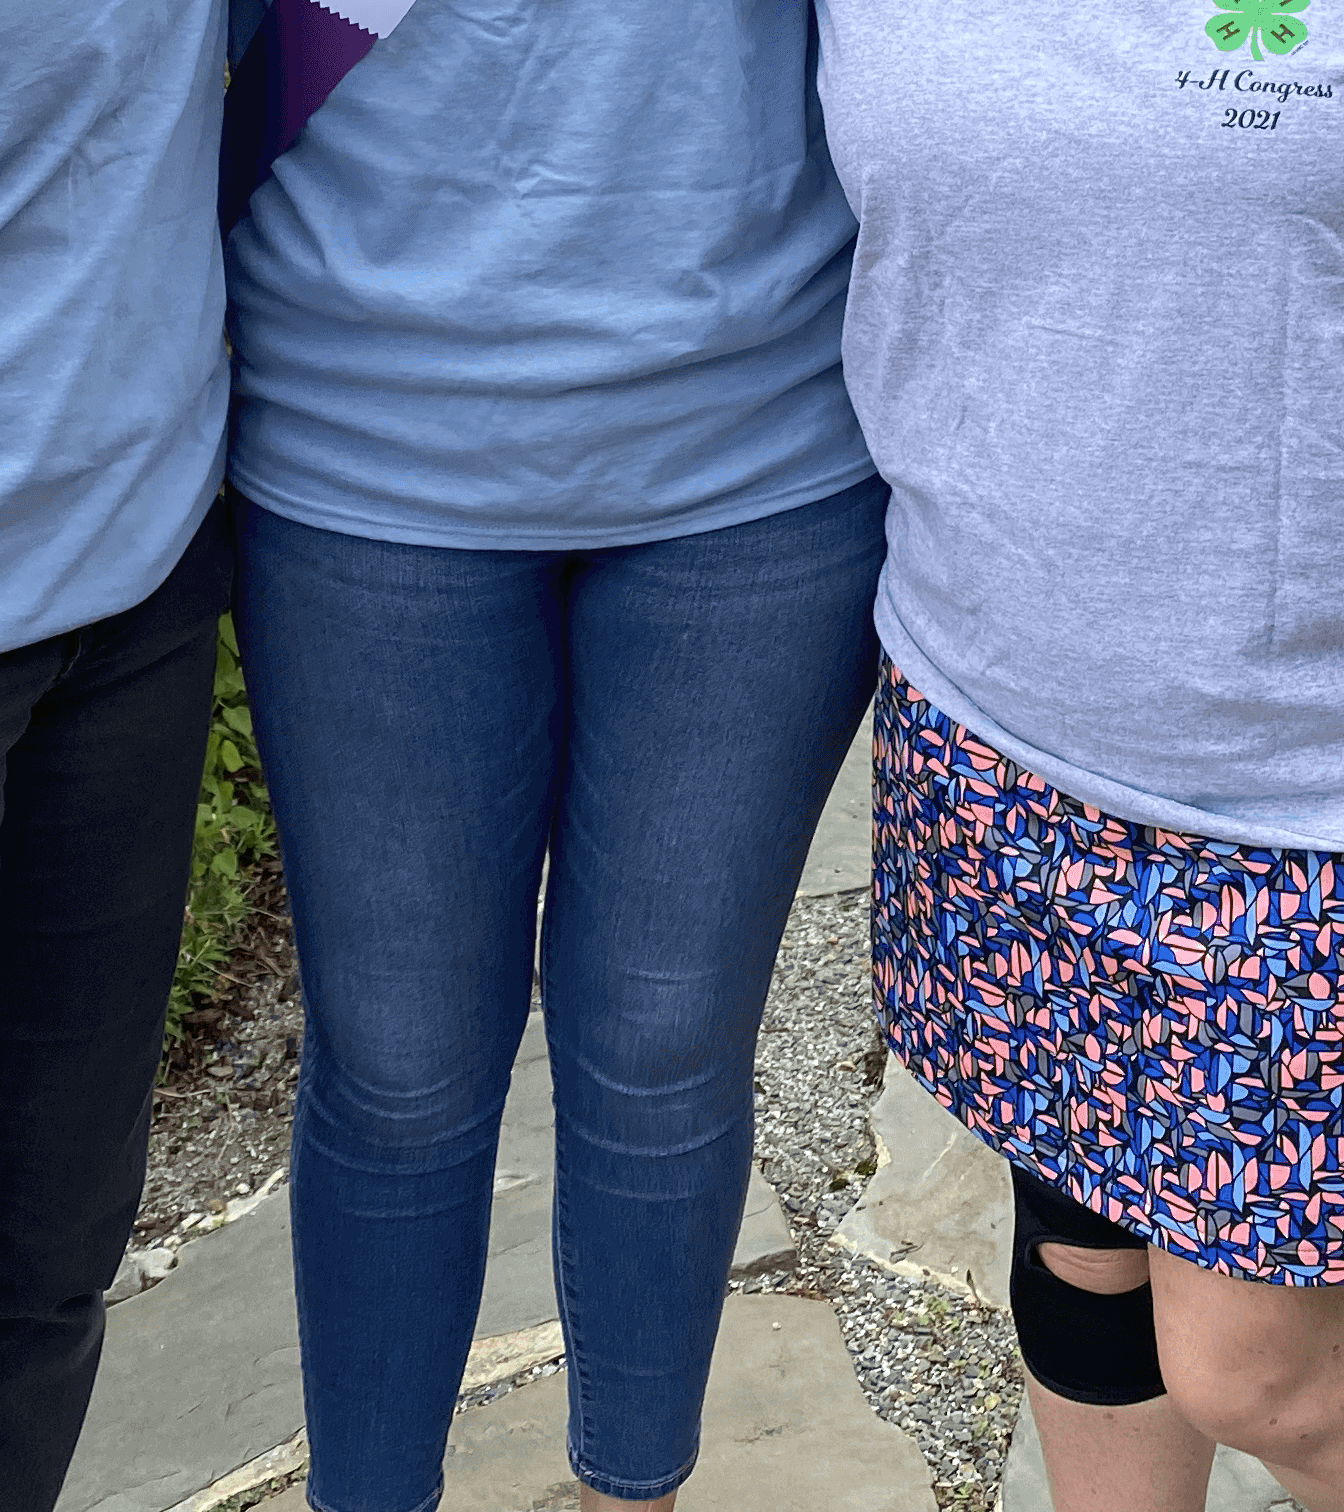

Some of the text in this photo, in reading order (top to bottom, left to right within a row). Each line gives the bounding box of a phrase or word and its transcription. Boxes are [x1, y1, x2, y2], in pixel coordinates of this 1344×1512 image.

[1175, 69, 1333, 103] 4-H Congress
[1221, 108, 1281, 131] 2021
